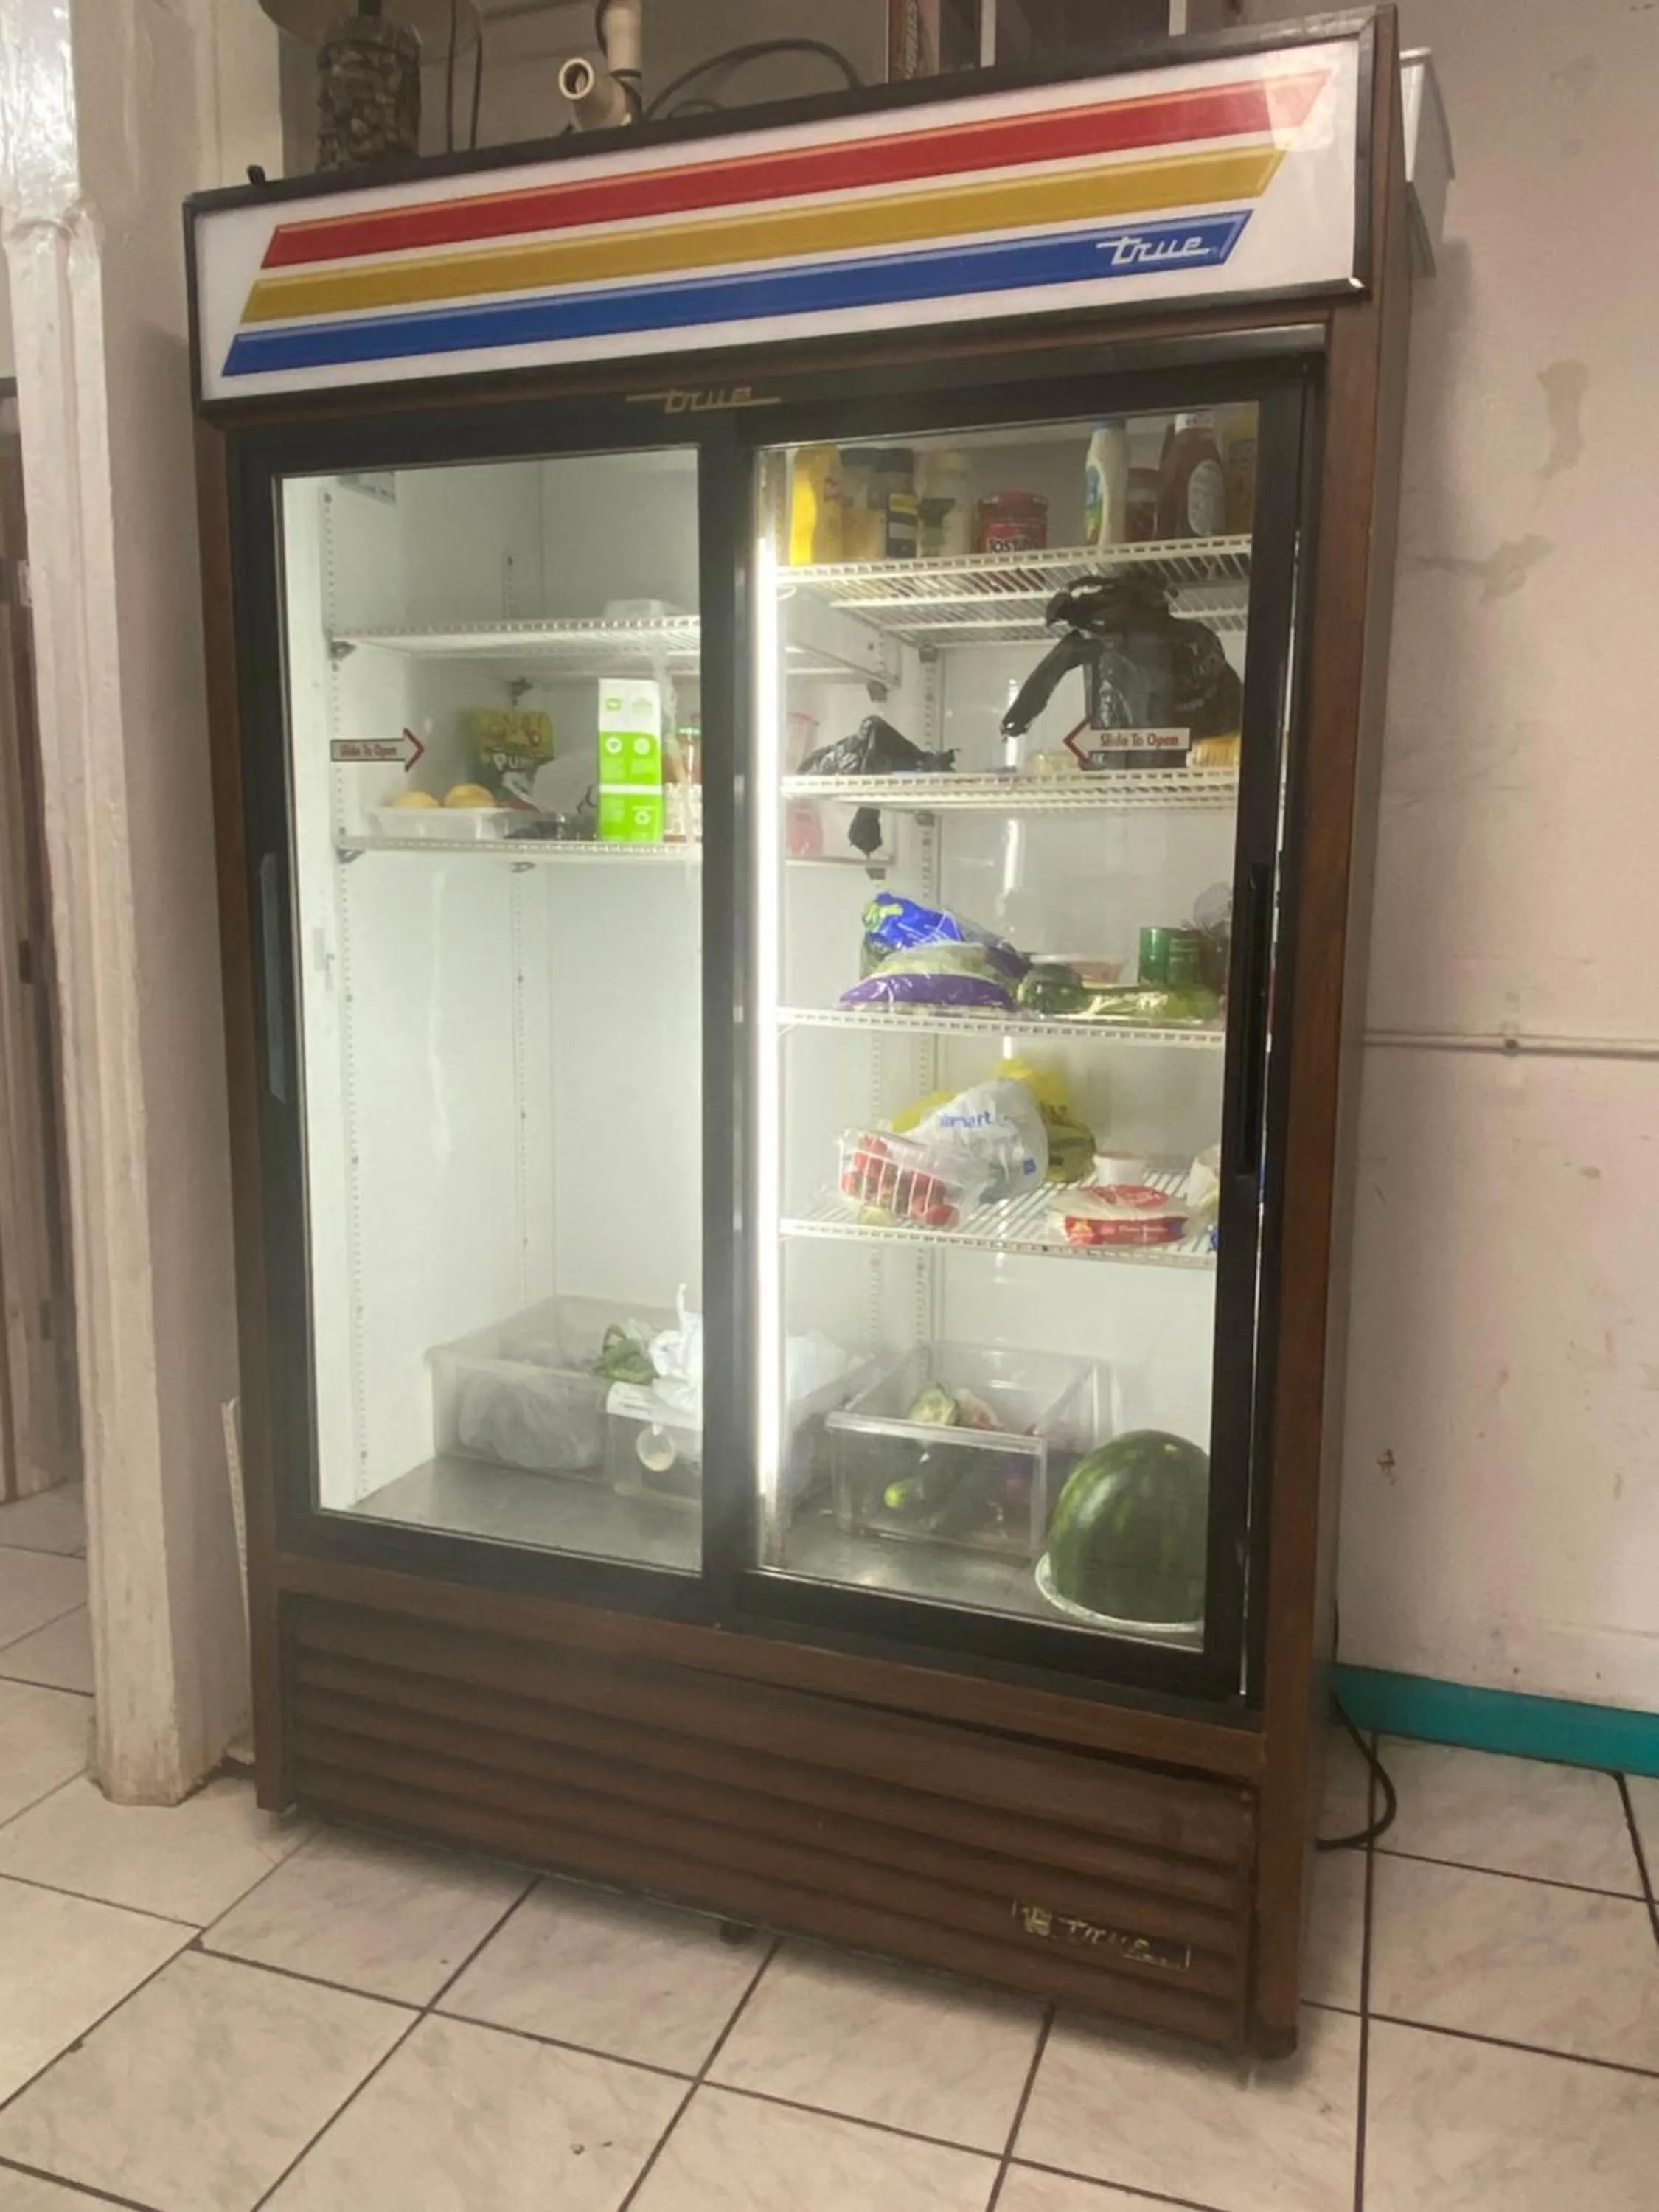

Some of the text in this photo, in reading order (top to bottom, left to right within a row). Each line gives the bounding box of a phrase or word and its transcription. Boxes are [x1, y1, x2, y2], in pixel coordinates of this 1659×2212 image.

[1100, 731, 1180, 751] Slide To Open
